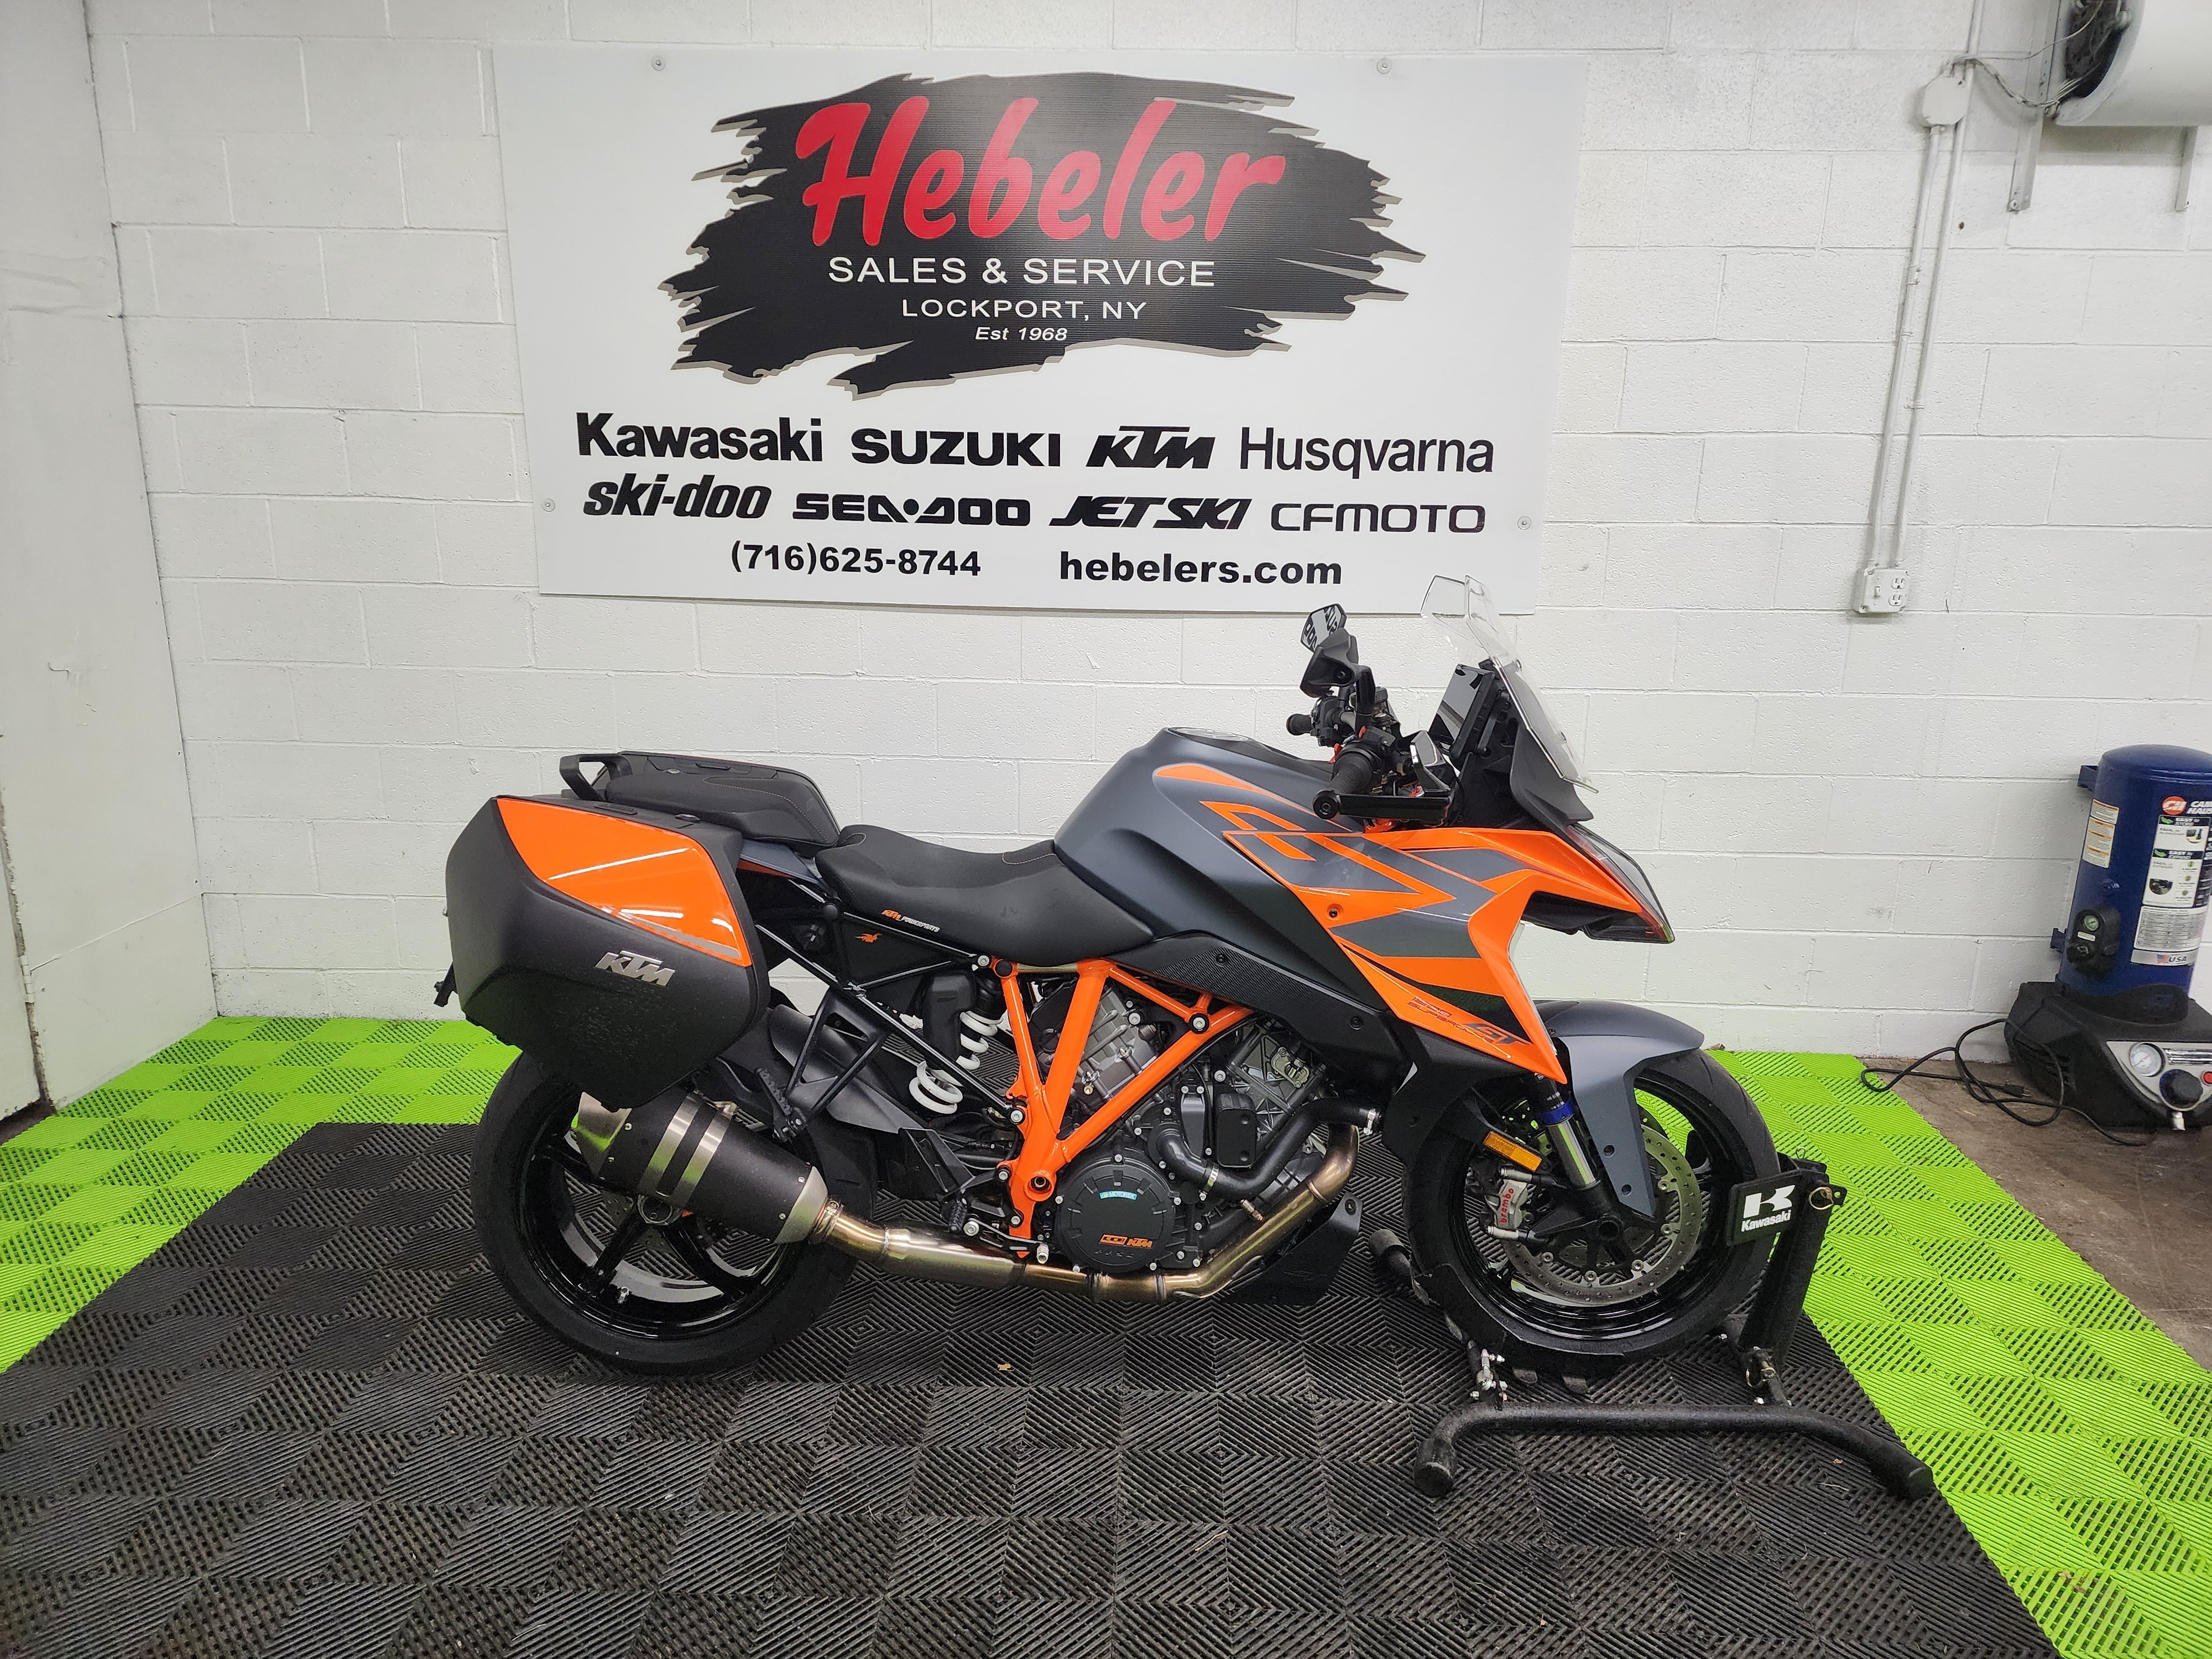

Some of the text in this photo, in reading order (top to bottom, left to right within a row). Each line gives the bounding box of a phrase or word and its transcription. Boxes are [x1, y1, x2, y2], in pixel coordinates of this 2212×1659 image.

[795, 97, 1285, 247] Hebeler
[828, 256, 1215, 286] SALES & SERVICE
[902, 299, 1147, 321] LOCKPORT, NY
[975, 326, 1068, 341] Est 1968
[576, 412, 1494, 479] Kawasaki SUZUKI KTM Husqvarna
[583, 473, 772, 519] ski-doo
[1271, 503, 1486, 533] CFMOTO
[732, 540, 1342, 585] (716)625-8744 hebelers.com
[881, 910, 941, 932] KTM POWERPARTS
[594, 950, 676, 987] KTM
[1499, 1188, 1514, 1223] brembo
[1741, 1209, 1792, 1232] Kawasaki
[1126, 1237, 1153, 1248] KTM
